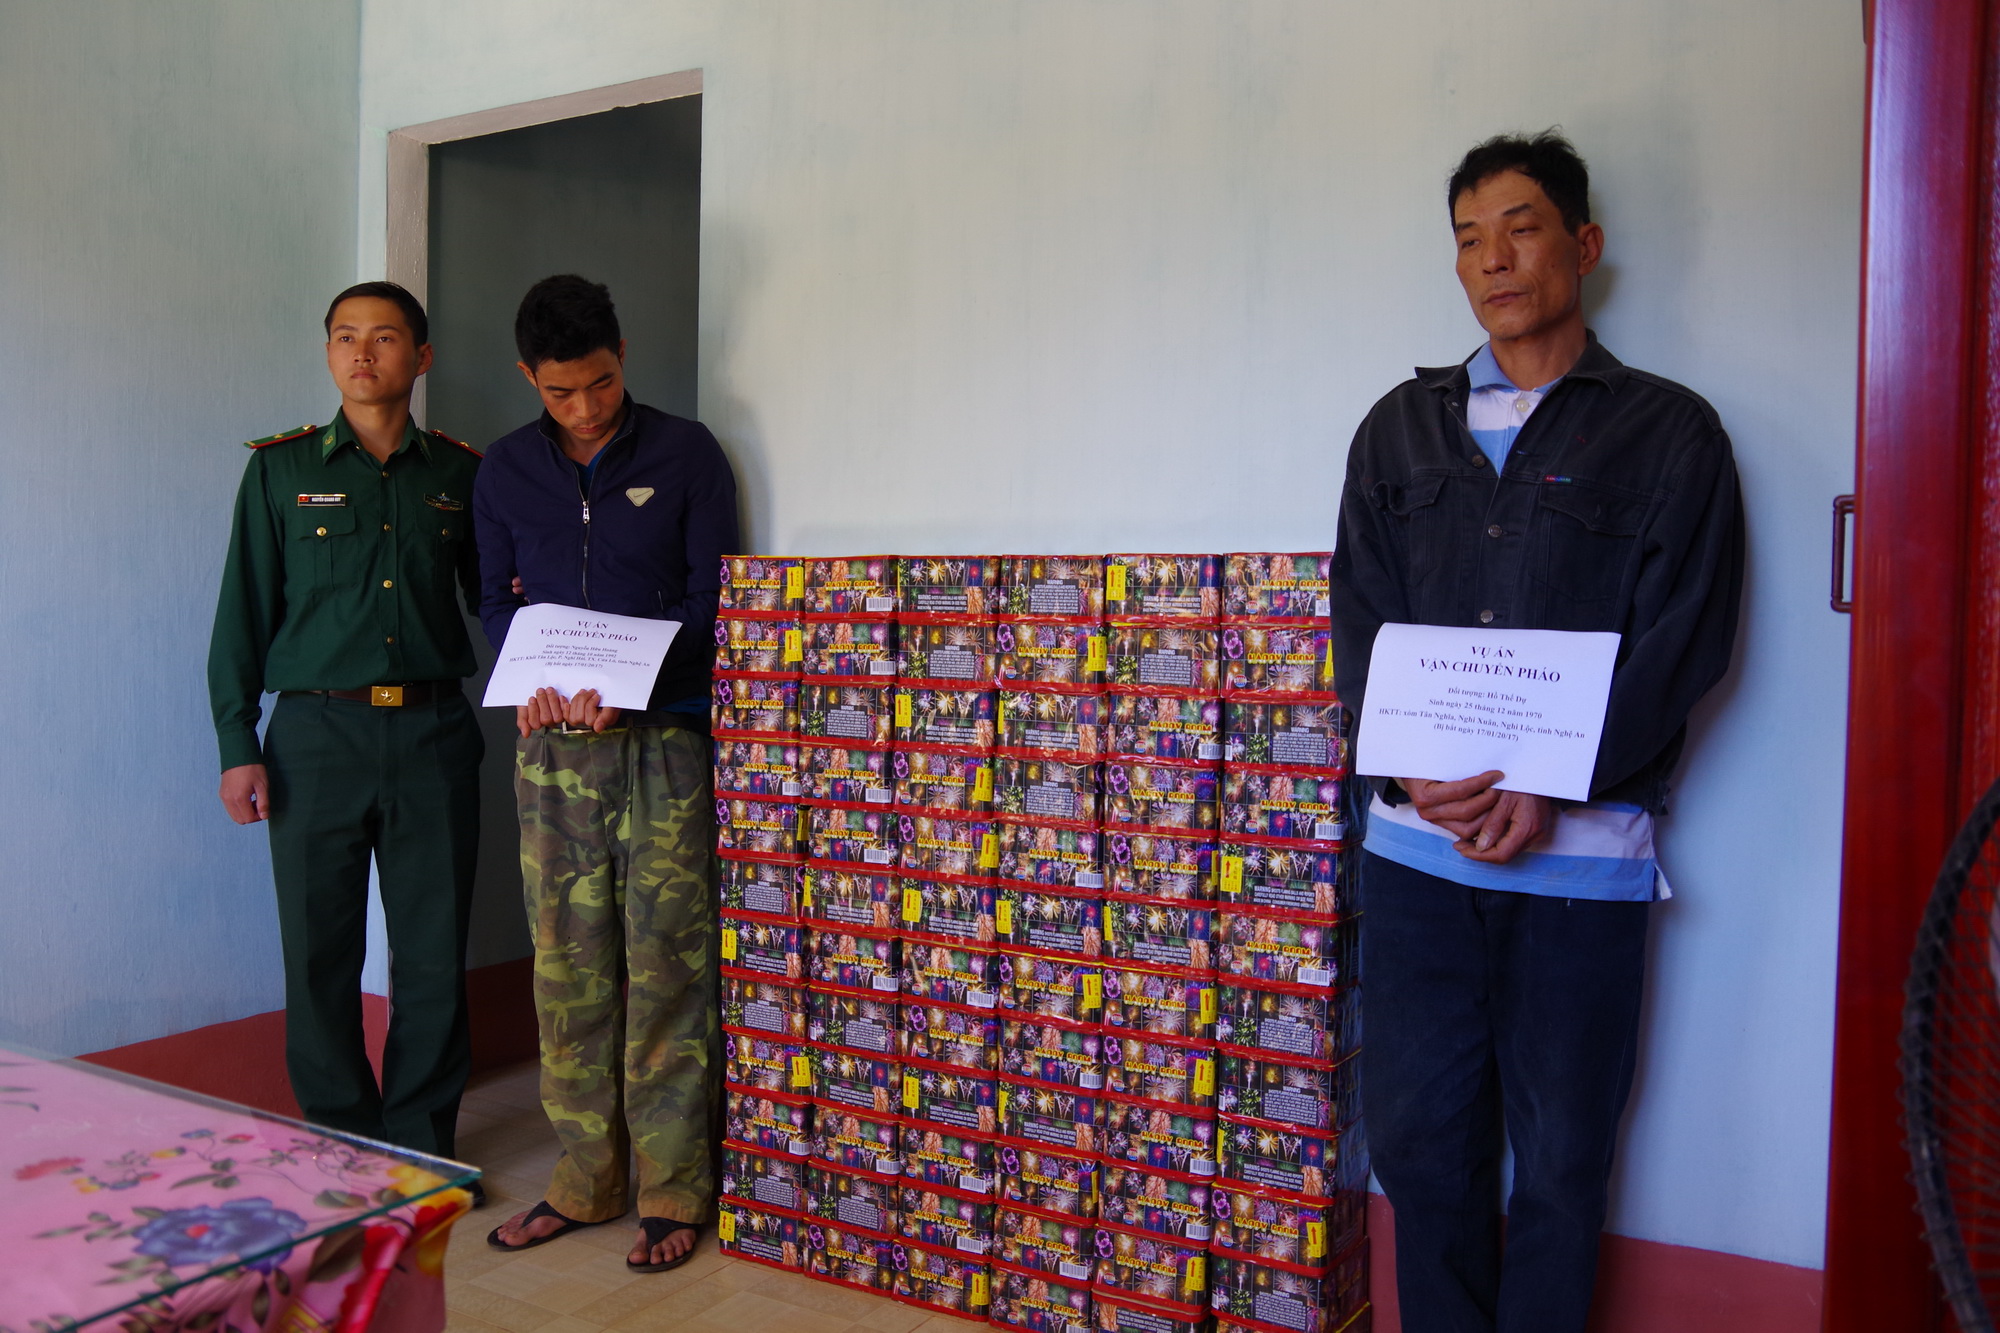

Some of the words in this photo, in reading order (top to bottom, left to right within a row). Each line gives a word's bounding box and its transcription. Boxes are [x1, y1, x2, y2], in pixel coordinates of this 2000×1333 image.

[577, 620, 592, 629] VỤ
[593, 620, 609, 629] ÁN
[539, 628, 561, 637] VẬN
[562, 629, 607, 639] CHUYỂN
[608, 632, 638, 642] PHÁO
[1471, 646, 1490, 659] VỤ
[1493, 645, 1515, 658] ÁN
[1420, 658, 1449, 672] VẬN
[1452, 660, 1514, 677] CHUYỂN
[1518, 666, 1561, 683] PHÁO
[1448, 686, 1460, 695] Đối
[1461, 689, 1486, 698] tượng:
[1487, 691, 1498, 699] Hồ
[1429, 699, 1444, 707] Sinh
[1446, 701, 1461, 709] ngày
[1474, 704, 1495, 713] tháng
[1507, 709, 1523, 717] năm
[1526, 711, 1542, 719] 1970
[1433, 723, 1444, 731] (Bị
[1445, 723, 1457, 731] bắt
[1458, 726, 1474, 734] ngày
[1477, 727, 1519, 741] 17/01/20/17)
[1459, 715, 1475, 723] Nghi
[1477, 717, 1498, 727] Xuân,
[1501, 721, 1519, 731] Nghi
[1520, 724, 1535, 733] Lộc,
[1537, 727, 1552, 735] tỉnh
[1554, 728, 1573, 739] Nghệ
